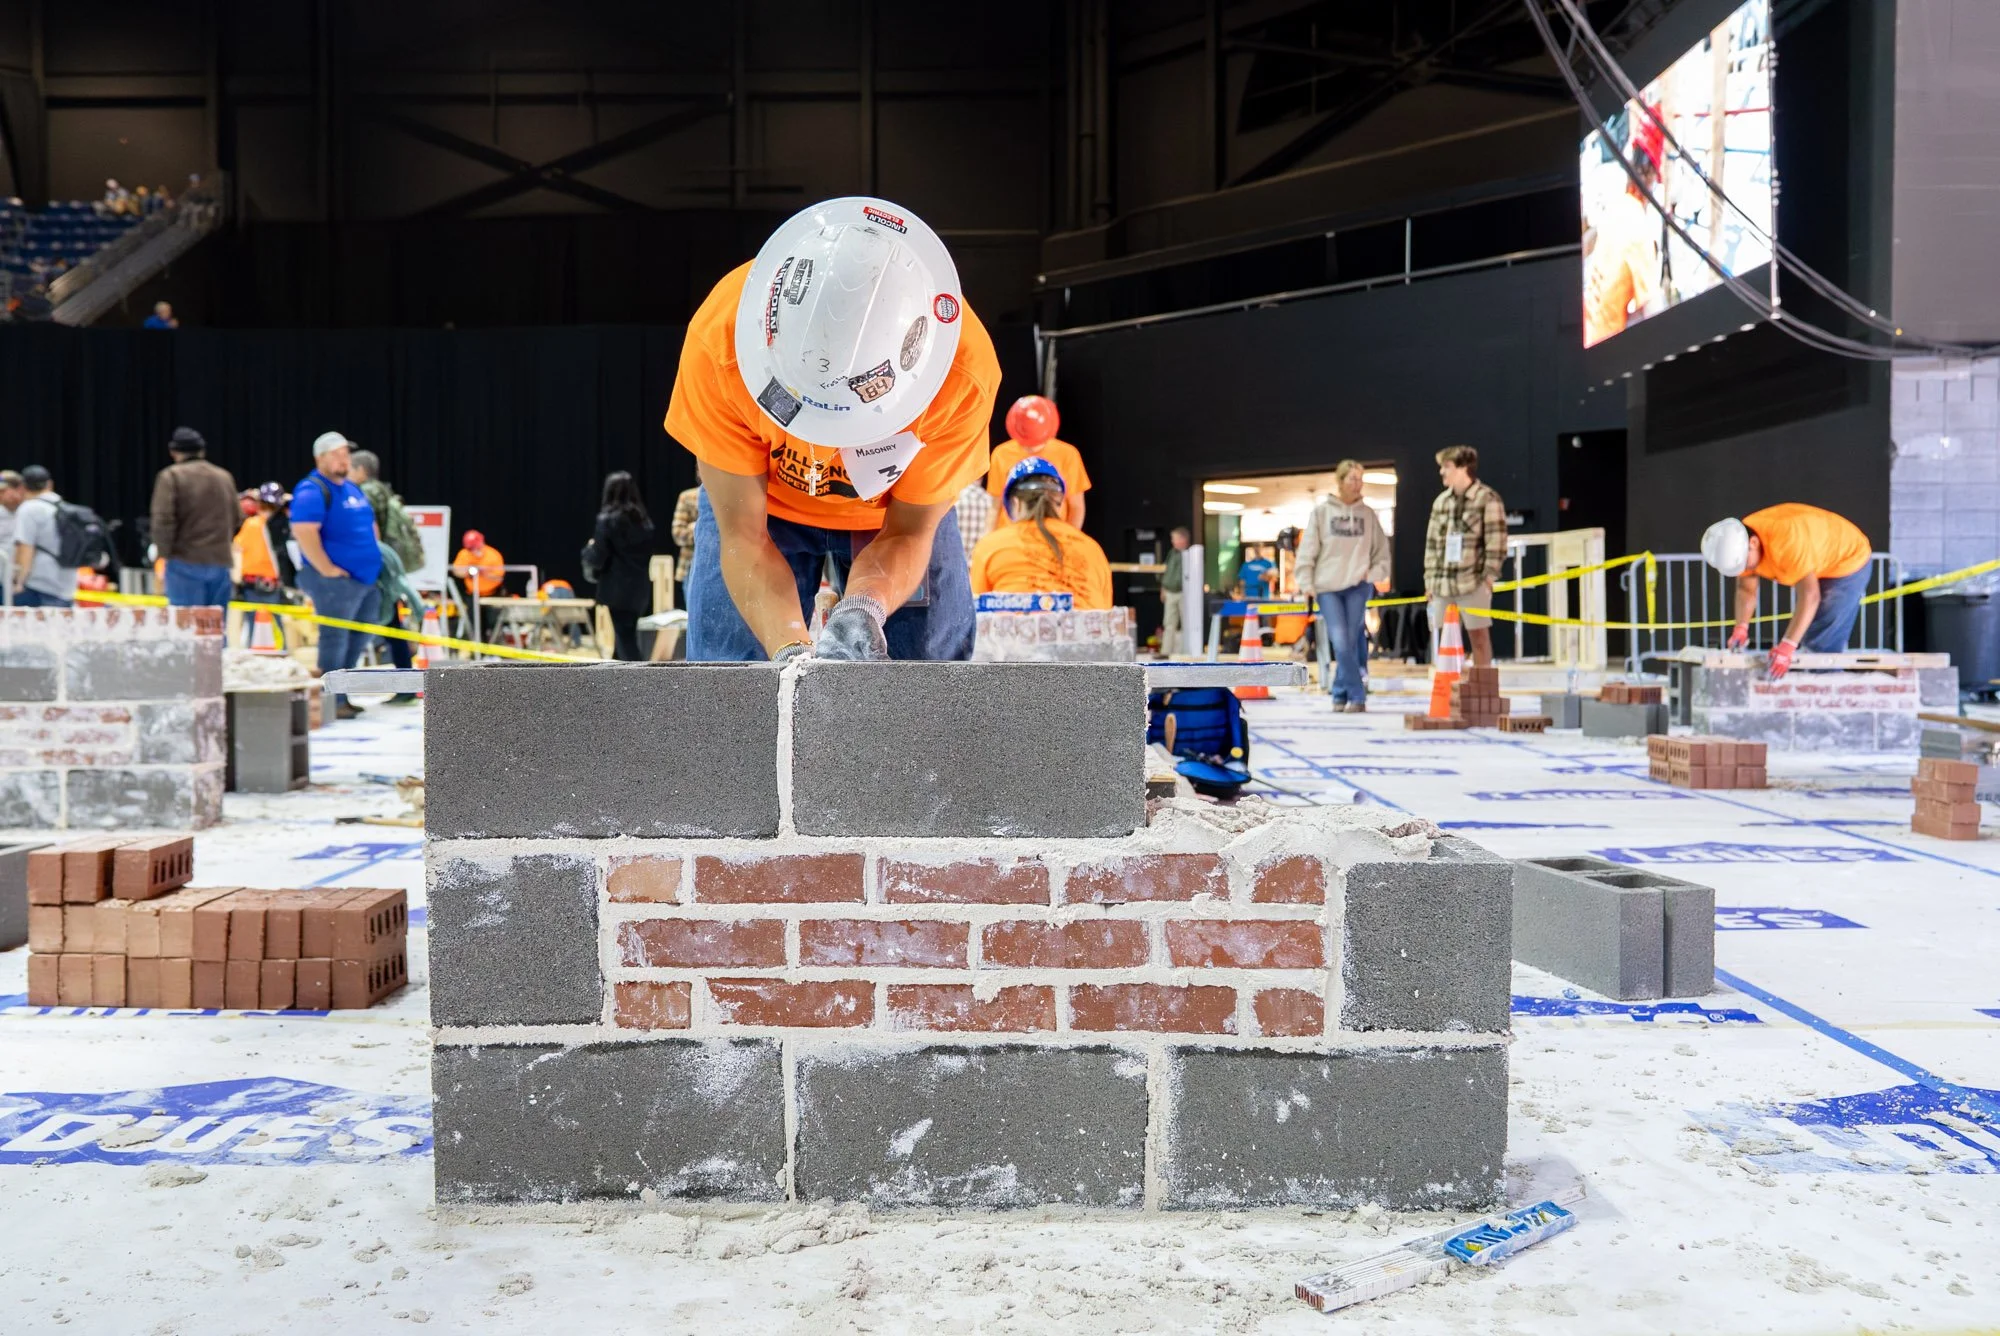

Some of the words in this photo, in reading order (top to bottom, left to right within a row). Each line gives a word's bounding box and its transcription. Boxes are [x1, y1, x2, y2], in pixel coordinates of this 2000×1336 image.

[867, 207, 901, 224] ELECTRIC
[868, 213, 907, 234] LINCOLN
[769, 258, 793, 332] LINCOLN
[819, 358, 831, 373] 3
[865, 379, 888, 399] 84
[802, 395, 851, 411] RaLin
[878, 464, 903, 483] 3
